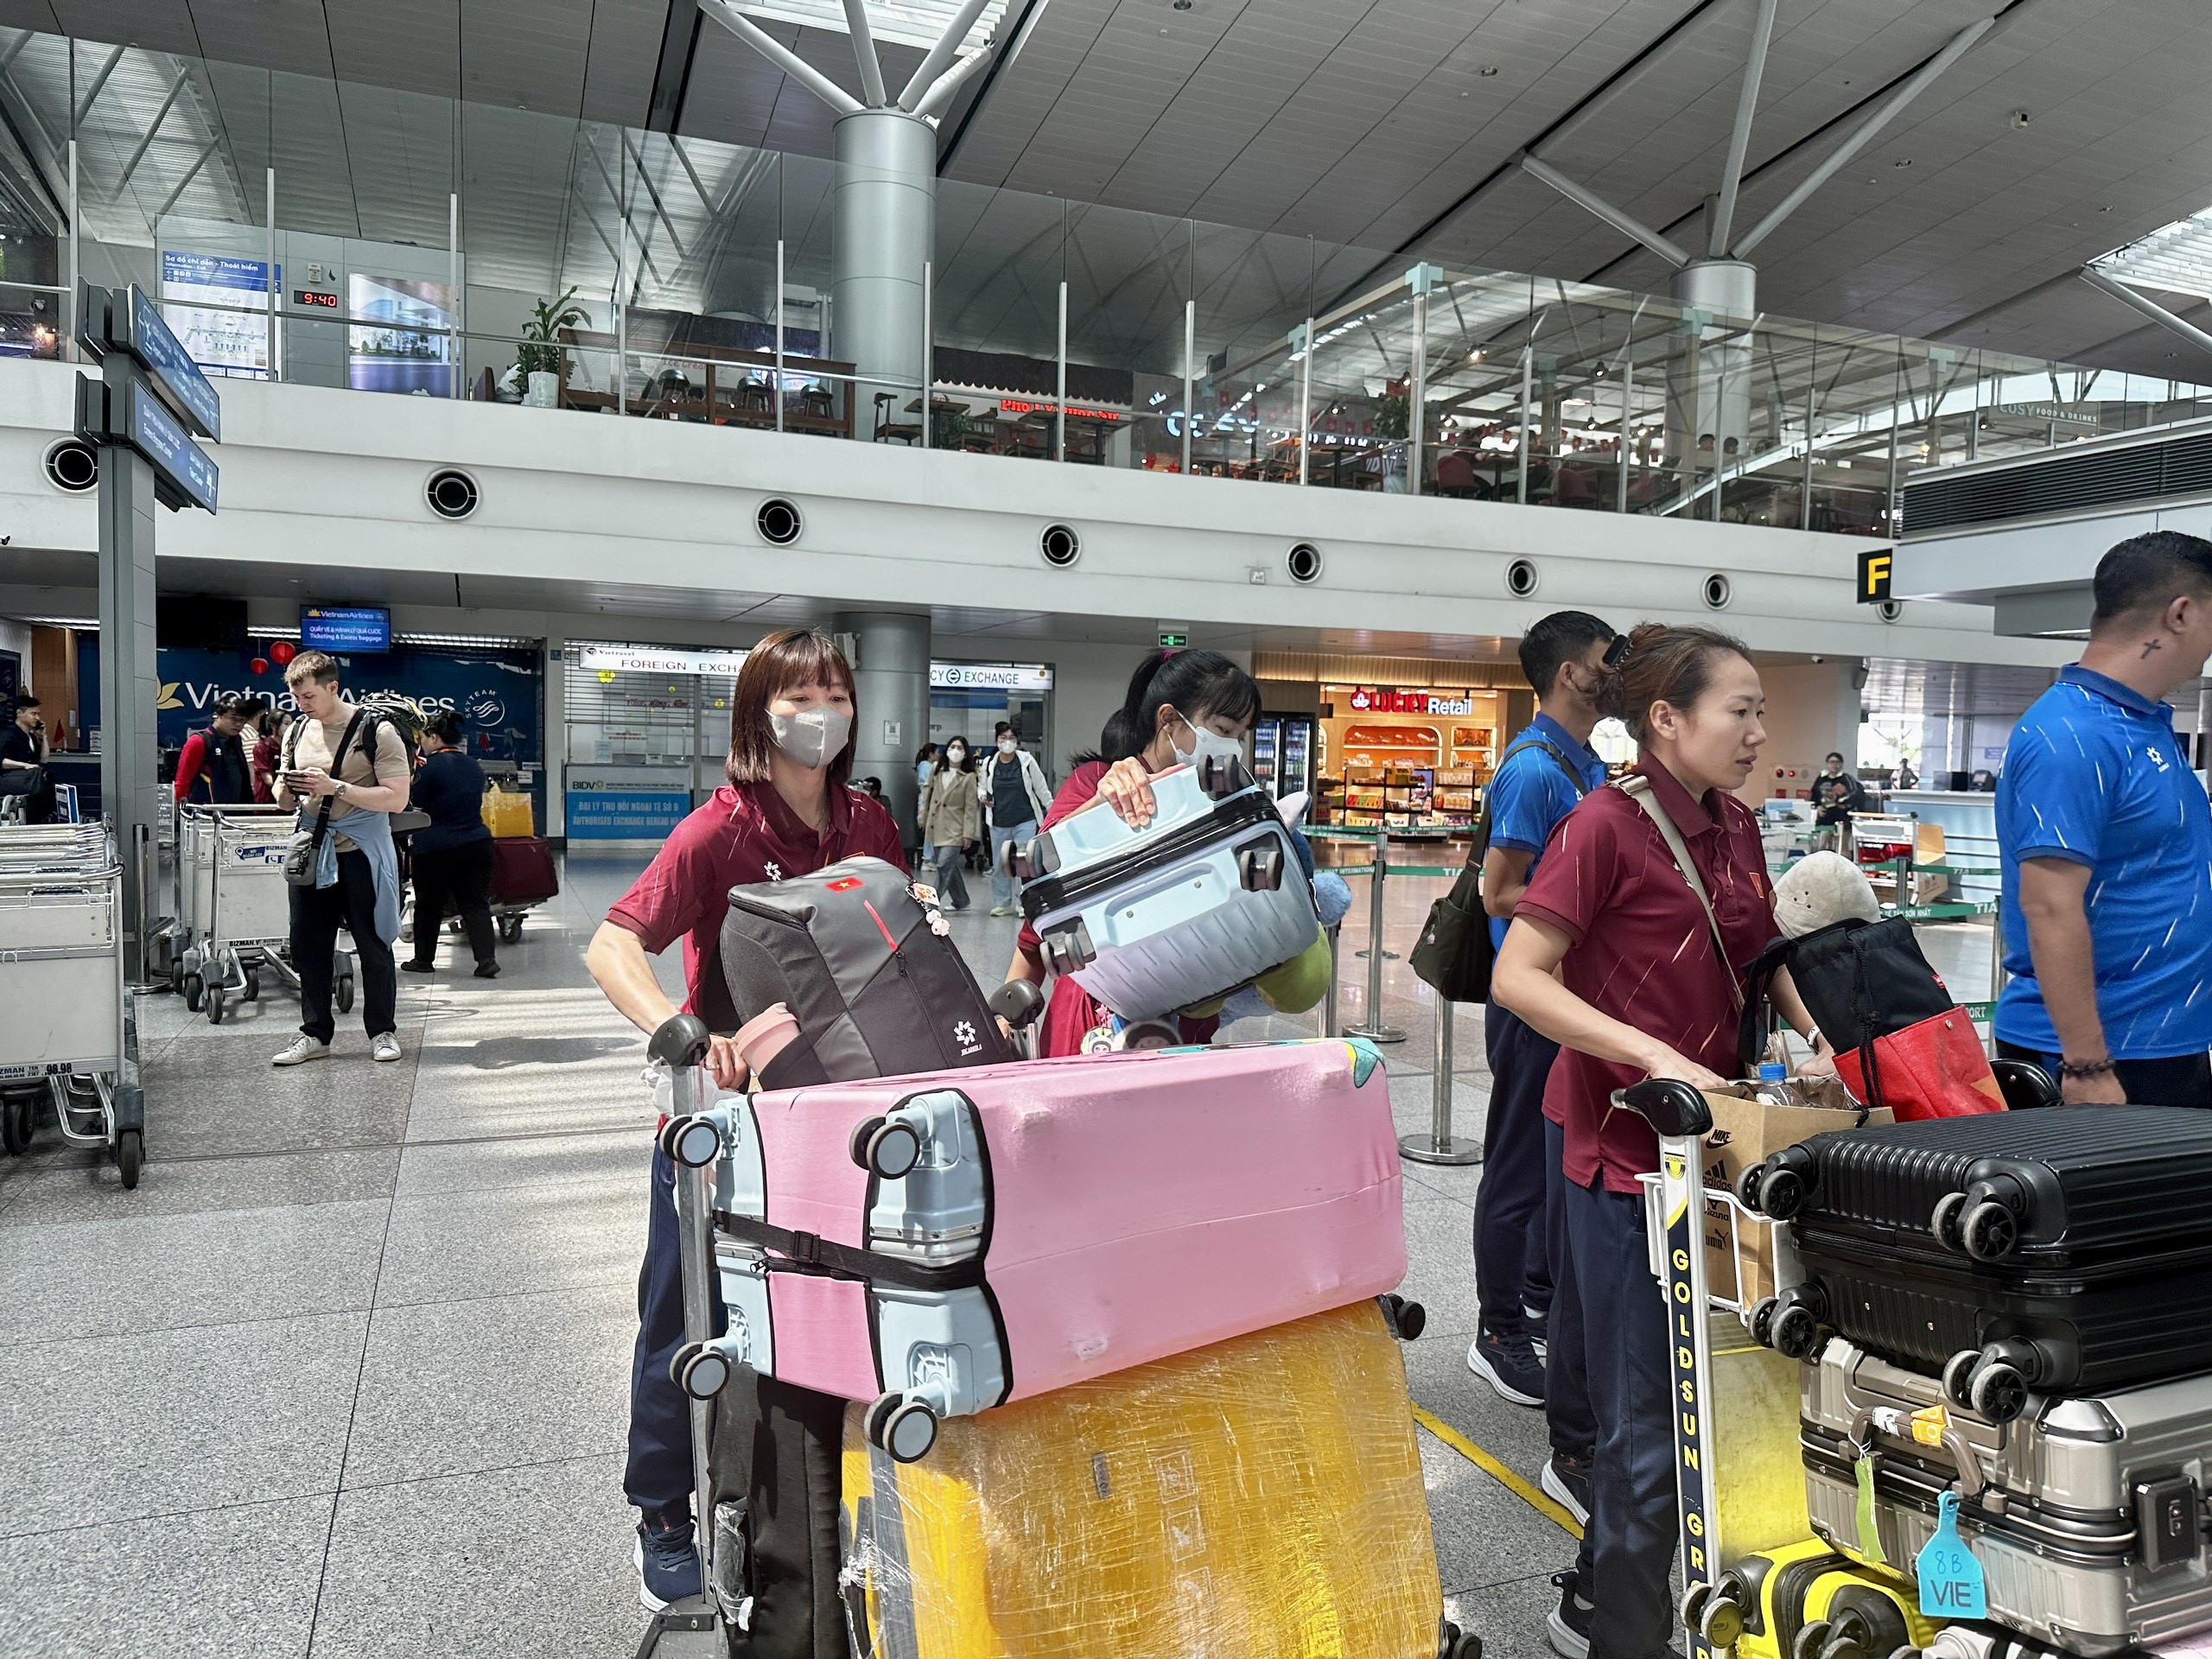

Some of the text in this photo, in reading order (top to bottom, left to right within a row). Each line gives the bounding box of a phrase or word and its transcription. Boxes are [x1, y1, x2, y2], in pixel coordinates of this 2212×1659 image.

[304, 293, 337, 308] 9:40
[2036, 408, 2057, 416] FOOD
[2068, 411, 2098, 423] DRINKS
[1867, 556, 1891, 596] F
[621, 659, 742, 673] FOREIGN EXCH
[964, 671, 1019, 684] EXCHANGE
[185, 682, 297, 712] Vitna
[464, 689, 497, 719] SKYTEAM
[1370, 692, 1472, 715] LUCKY Retail
[572, 781, 595, 790] BIDV
[573, 816, 613, 826] AUTHORISED
[613, 817, 645, 826] EXCHANGE
[1340, 867, 1376, 875] INTERNATIONA
[1974, 902, 1999, 914] TIA
[0, 1066, 25, 1075] ZMAN
[1711, 1128, 1732, 1142] NIKE
[1702, 1176, 1733, 1192] adidas
[1705, 1234, 1723, 1251] UMA
[1672, 1249, 1699, 1471] GOLDSUN
[1929, 1580, 1972, 1608] VIE
